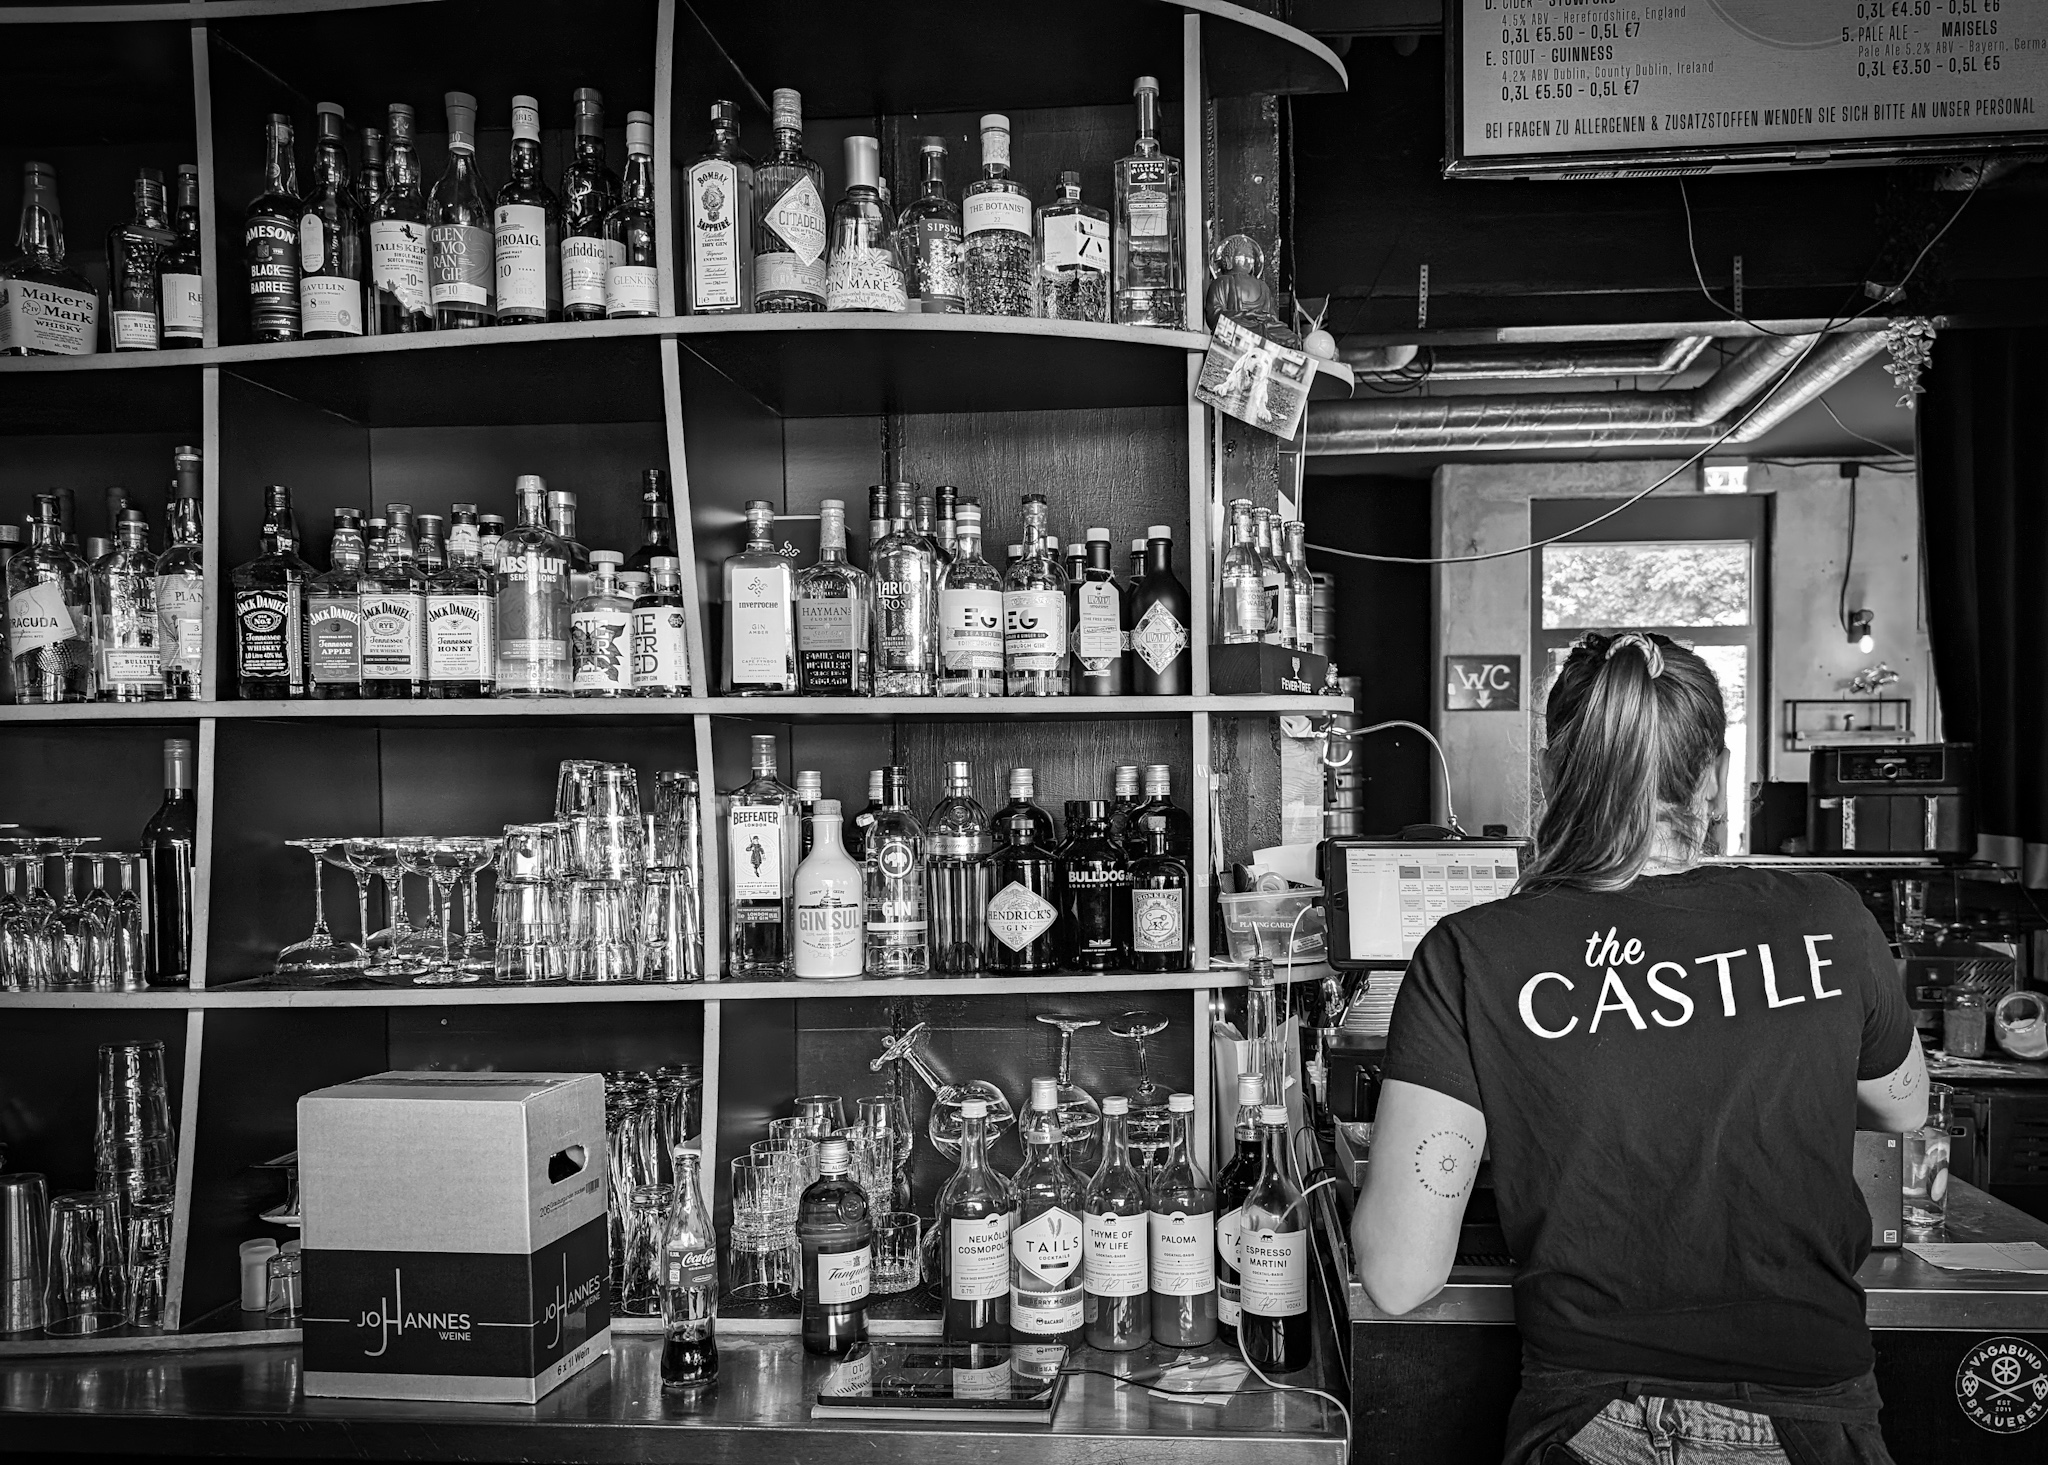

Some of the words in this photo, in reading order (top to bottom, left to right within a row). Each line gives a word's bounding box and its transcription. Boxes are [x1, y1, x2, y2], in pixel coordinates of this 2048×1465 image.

[1502, 14, 1526, 27] 4.5%
[1531, 13, 1549, 25] ABV
[1564, 8, 1640, 24] Herefordshire,
[1646, 6, 1686, 22] England
[1857, 2, 1885, 20] 0,3L
[1891, 0, 1931, 17] €4.50
[1502, 28, 1530, 46] 0,3L
[1536, 26, 1573, 42] €5.50
[1591, 24, 1619, 41] 0,5L
[1625, 22, 1641, 37] €7
[1842, 26, 1854, 43] 5.
[1858, 26, 1883, 43] PALE
[1889, 25, 1908, 41] ALE
[1942, 20, 1998, 38] MAISELS
[1486, 51, 1497, 66] E.
[1502, 49, 1535, 66] STOUT
[1552, 46, 1613, 63] GUINNESS
[1858, 44, 1880, 58] Pale
[1885, 44, 1901, 56] Ale
[1906, 42, 1931, 55] 5.2%
[1936, 42, 1954, 54] ABV
[1969, 40, 2009, 54] Bayern,
[1502, 70, 1526, 83] 4.2%
[1532, 69, 1549, 81] ABV
[1554, 67, 1590, 81] Dublin,
[1595, 66, 1631, 80] County
[1636, 64, 1673, 77] Dublin,
[1677, 61, 1714, 75] Ireland
[1858, 62, 1886, 79] 0,3L
[1892, 59, 1931, 76] €3.50
[1949, 58, 1978, 74] 0,5L
[1984, 56, 2000, 72] €5
[1502, 86, 1529, 103] 0,3L
[1535, 83, 1573, 99] €5.50
[1590, 82, 1618, 99] 0,5L
[1624, 80, 1640, 96] €7
[1486, 122, 1503, 139] BEI
[1508, 120, 1550, 138] FRAGEN
[1556, 119, 1569, 136] ZU
[1574, 116, 1645, 135] ALLERGENEN
[1651, 115, 1659, 131] &
[1665, 111, 1758, 132] ZUSATZSTOFFEN
[1764, 108, 1812, 127] WENDEN
[1818, 106, 1836, 124] SIE
[1842, 104, 1868, 122] SICH
[1874, 104, 1906, 121] BITTE
[1911, 102, 1926, 119] AN
[1932, 100, 1970, 119] UNSER
[1976, 98, 2036, 116] PERSONAL
[697, 172, 729, 188] BOMBAY
[970, 204, 984, 214] THE
[986, 202, 1025, 214] BOTANIST
[696, 217, 731, 232] SAPPHIRE
[778, 210, 825, 236] CITADELLE
[431, 228, 464, 243] GLEN
[374, 243, 427, 256] TALISKER
[441, 241, 467, 255] MO
[432, 254, 457, 269] RAN
[251, 264, 281, 277] BLACK
[442, 268, 463, 281] GIE
[499, 264, 512, 278] 10
[406, 273, 417, 286] 10
[848, 280, 890, 292] MARE
[250, 281, 286, 295] BARREL
[448, 285, 458, 295] 10
[21, 286, 94, 311] Maker's
[310, 298, 317, 309] 8
[34, 320, 83, 333] WHISKY
[499, 556, 567, 575] ABSLUT
[510, 574, 557, 583] SENSIONS
[237, 598, 256, 617] JACK
[362, 605, 381, 622] JACK
[428, 606, 448, 623] JACK
[254, 618, 272, 626] No.7
[310, 609, 329, 626] JACK
[246, 633, 282, 642] Tennessee
[318, 640, 354, 648] Tennessee
[370, 636, 404, 644] Tennessee
[437, 637, 473, 645] Tennessee
[1453, 664, 1511, 691] WC
[733, 811, 779, 826] BEEFEATER
[1068, 870, 1125, 883] BULLDOG
[882, 901, 912, 917] GIN
[988, 909, 1052, 921] HENDRICK'S
[799, 911, 827, 931] GIN
[832, 910, 860, 930] SUL
[1585, 926, 1645, 968] the
[1518, 934, 1843, 1039] CASTLE
[1090, 1229, 1118, 1240] THYME
[1122, 1230, 1133, 1239] OF
[1161, 1235, 1197, 1245] PALOMA
[1026, 1236, 1079, 1253] TAILS
[1094, 1241, 1107, 1250] MY
[1109, 1242, 1129, 1250] LIFE
[1246, 1245, 1292, 1257] ESPRESSO
[682, 1248, 716, 1268] Coca-Cola
[1250, 1258, 1288, 1268] MARTINI
[851, 1284, 863, 1296] 0.0
[543, 1252, 601, 1350] JOHANNES
[584, 1292, 601, 1308] WEINE
[356, 1268, 472, 1357] JOHANNES
[438, 1332, 472, 1341] WEINE
[557, 1365, 562, 1377] 6
[574, 1347, 590, 1365] Wein
[1969, 1344, 2042, 1370] VAGABUND
[1966, 1398, 2043, 1428] BRAUEREI
